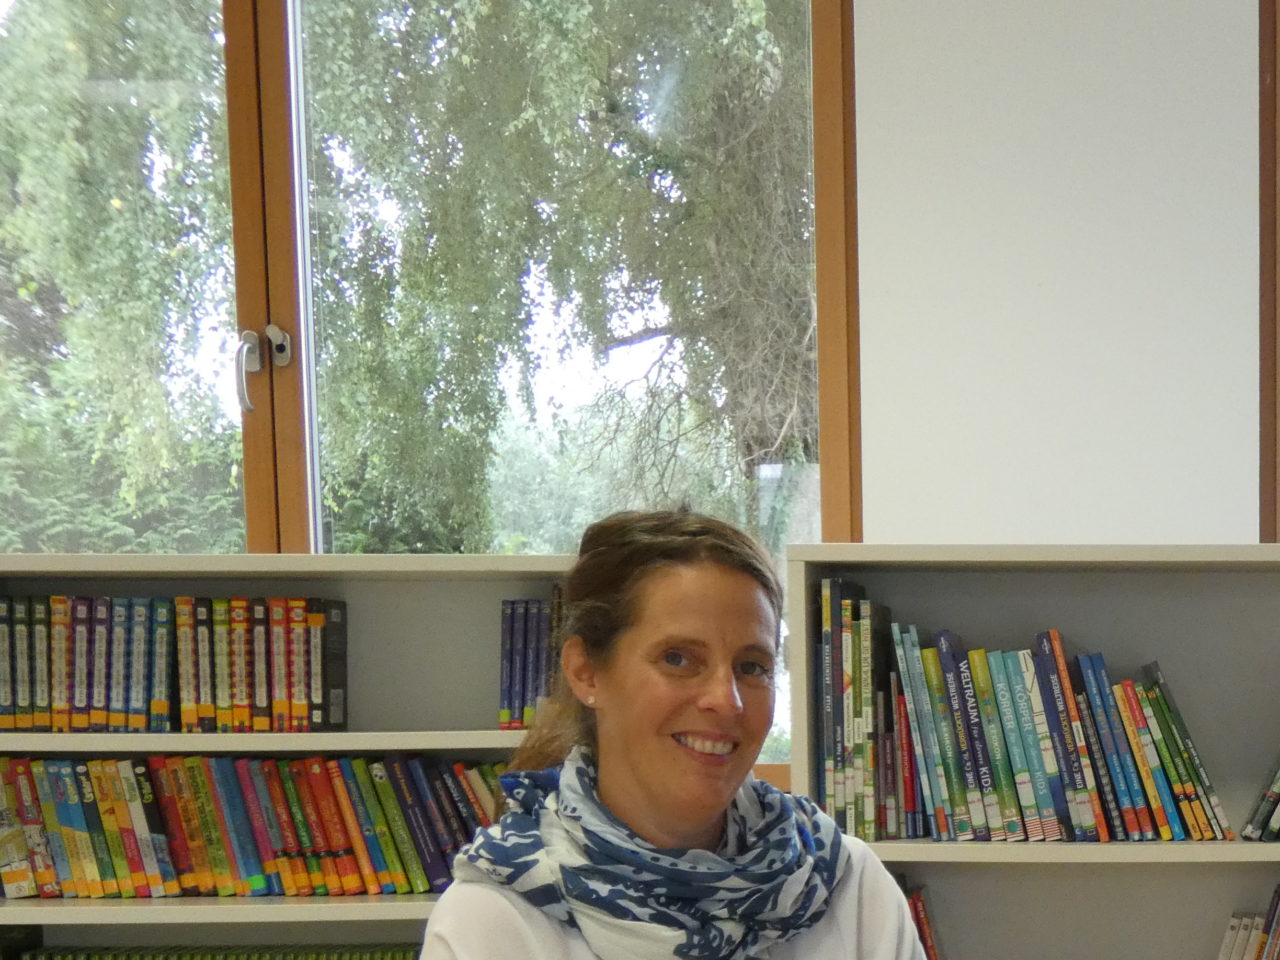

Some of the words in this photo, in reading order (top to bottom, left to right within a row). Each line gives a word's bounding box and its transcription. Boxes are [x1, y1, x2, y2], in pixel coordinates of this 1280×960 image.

[959, 660, 979, 723] WELTRAUM
[979, 766, 993, 793] KIDS
[997, 683, 1015, 730] KÖRPER
[1015, 684, 1033, 731] KÖRPER
[1034, 772, 1048, 795] KIDS
